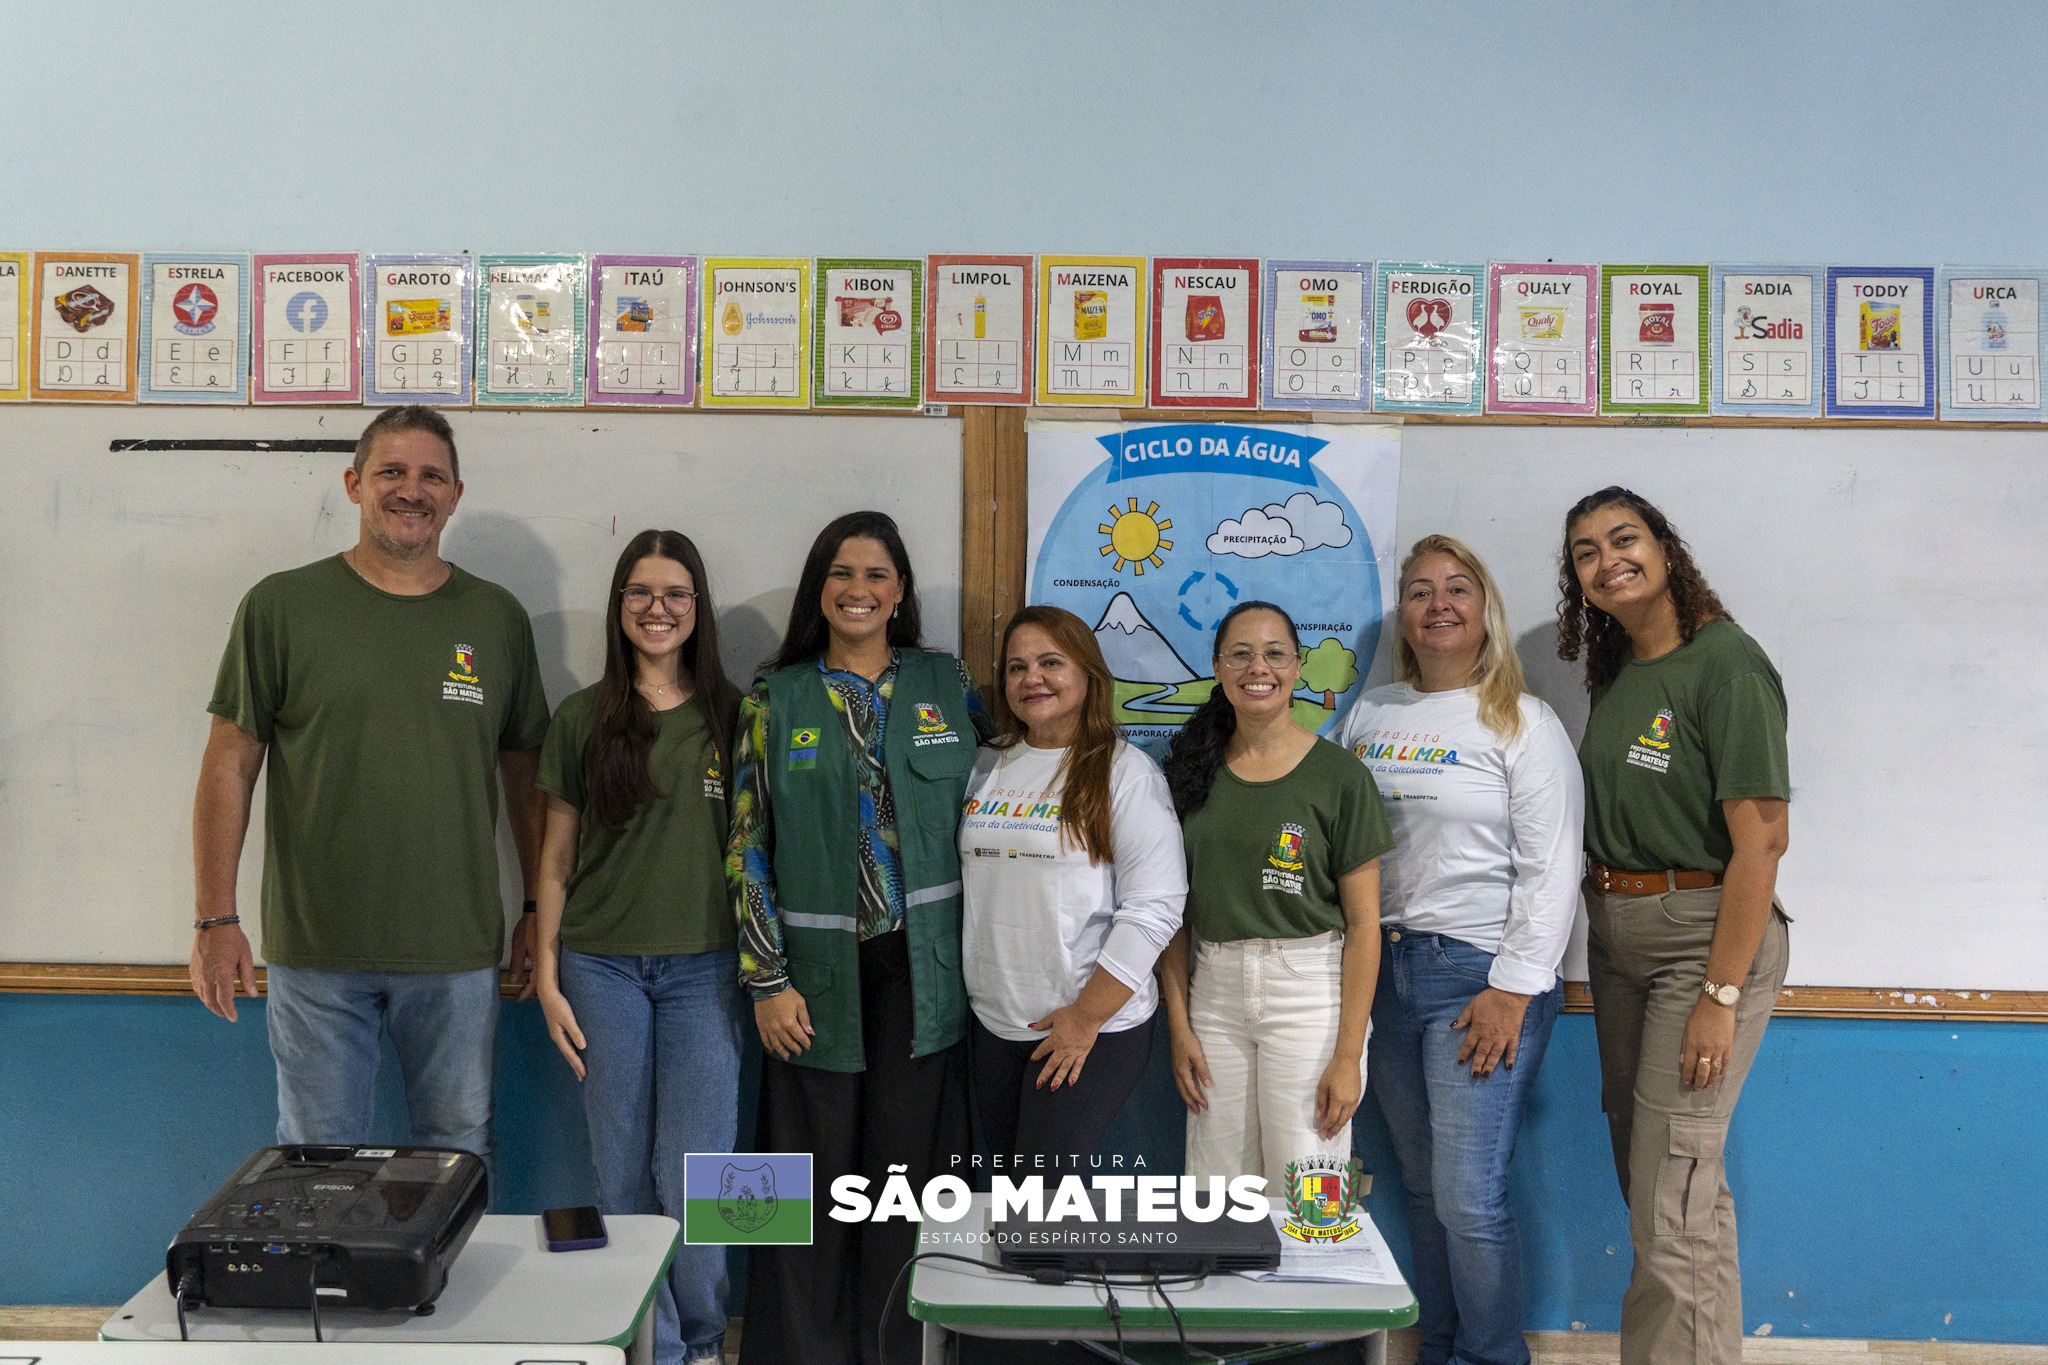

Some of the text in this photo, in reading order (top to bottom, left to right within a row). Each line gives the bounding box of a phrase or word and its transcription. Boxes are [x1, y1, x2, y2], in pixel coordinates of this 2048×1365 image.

[56, 267, 116, 277] DANETTE
[169, 267, 224, 279] ESTRELA
[270, 272, 344, 283] FACEBOOK
[625, 269, 663, 285] ITAÚ
[387, 273, 450, 285] GAROTO
[845, 279, 893, 291] KIBON
[952, 273, 1010, 285] LIMPOL
[1058, 273, 1128, 286] MAIZENA
[1175, 277, 1236, 290] NESCAU
[1300, 278, 1338, 291] OMO
[718, 282, 796, 294] JOHNSON'S
[1392, 279, 1471, 294] PERDIGÃO
[1518, 283, 1571, 295] QUALY
[1630, 284, 1681, 295] ROYAL
[1745, 284, 1792, 295] SADIA
[1853, 285, 1908, 297] TODDY
[1974, 287, 2017, 299] URCA
[1081, 305, 1106, 315] MAIZENA
[1311, 312, 1327, 320] OMO
[746, 313, 796, 329] Johnson's
[1528, 314, 1555, 328] Qualy
[1644, 315, 1671, 328] ROYAL
[1752, 316, 1803, 339] Sadia
[1870, 313, 1897, 334] Toddy
[58, 341, 108, 359] D d
[171, 343, 219, 360] E e
[284, 342, 332, 360] F f
[392, 345, 442, 364] G g
[505, 344, 555, 362] H h
[732, 346, 738, 367] J
[844, 347, 891, 363] K k
[956, 344, 965, 359] L
[1065, 344, 1118, 361] M m
[1179, 347, 1228, 364] N n
[1291, 349, 1342, 367] O o
[1405, 352, 1453, 373] P p
[1515, 353, 1566, 374] Q q
[1630, 354, 1678, 370] R r
[1743, 354, 1791, 371] S s
[1854, 356, 1902, 373] T t
[1969, 358, 2019, 375] U u
[1125, 436, 1300, 468] CICLO DA ÁGUA
[1224, 534, 1286, 545] PRECIPITAÇÃO
[1054, 577, 1120, 589] CONDENSAÇÃO
[1295, 622, 1352, 633] ANSPIRAÇÃO
[460, 689, 483, 700] MATEUS
[915, 736, 959, 747] SÃO MATEUS
[1374, 731, 1439, 743] PROJETO
[1398, 746, 1460, 764] LIMPA
[1630, 745, 1661, 757] PREFEITURA
[1628, 751, 1640, 759] SÃO
[1641, 754, 1669, 768] MATEUS
[1376, 764, 1385, 772] da
[1389, 764, 1443, 775] Coletividade
[989, 789, 1054, 799] PROJETO
[988, 820, 999, 828] da
[1003, 821, 1058, 833] Coletividade
[1263, 874, 1278, 884] SÃO
